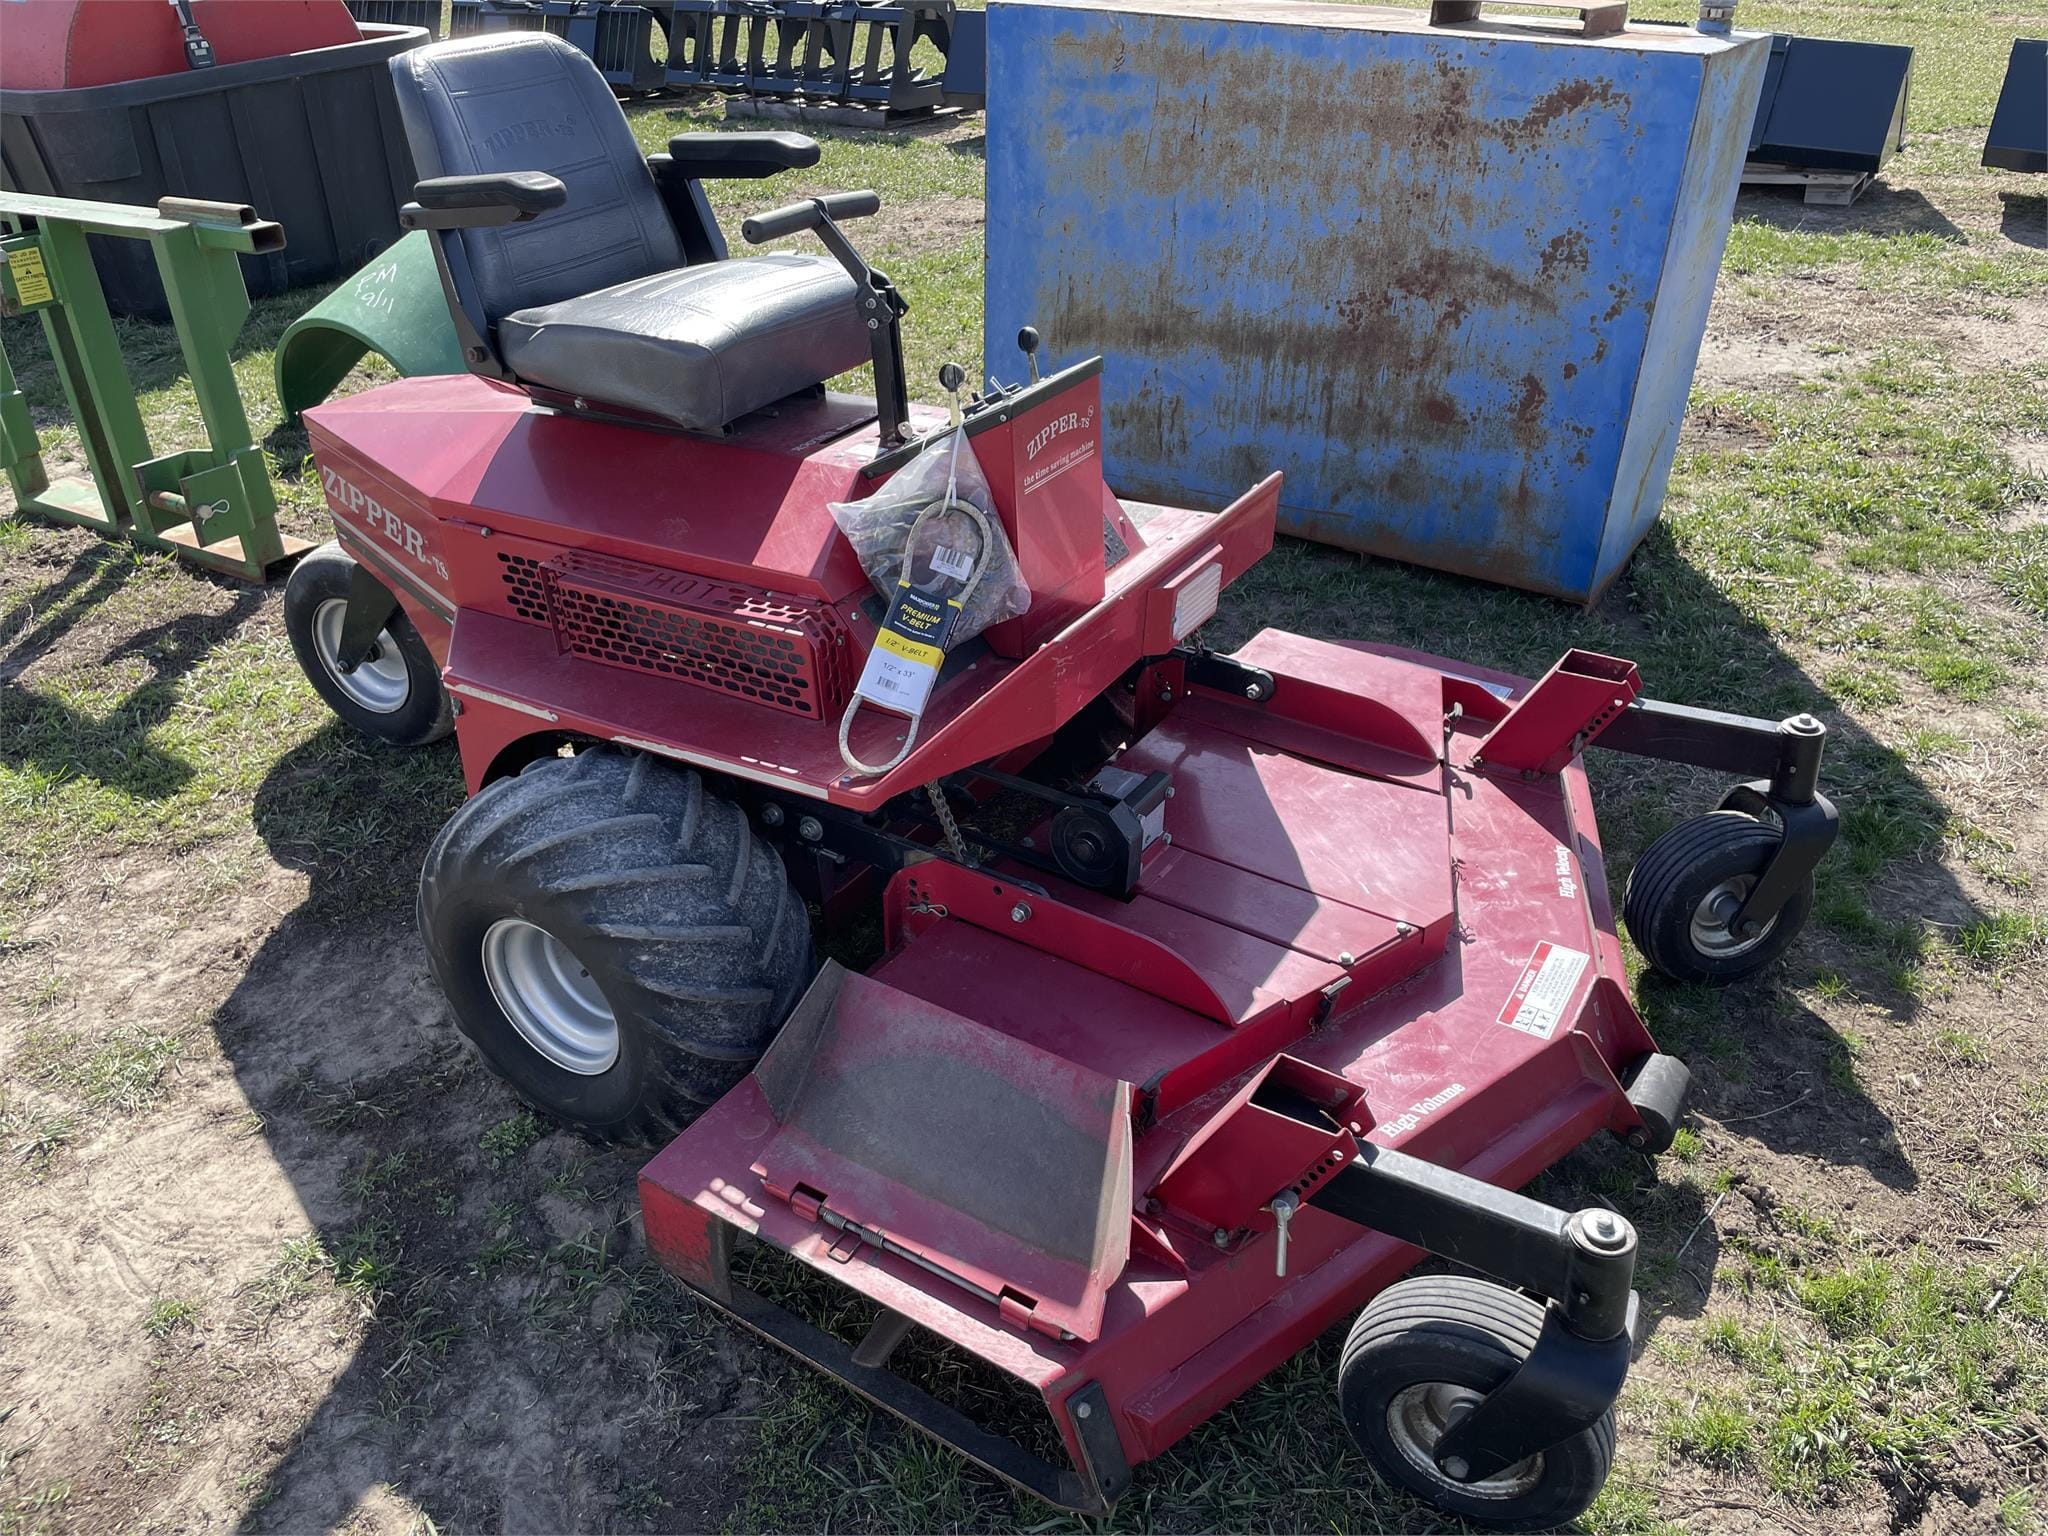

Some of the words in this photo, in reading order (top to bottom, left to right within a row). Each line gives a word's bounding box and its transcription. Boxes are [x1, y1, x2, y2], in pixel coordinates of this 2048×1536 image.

[1023, 475, 1035, 487] the
[1035, 466, 1050, 480] time
[1050, 453, 1070, 472] saving
[1070, 440, 1094, 460] machine
[643, 572, 724, 600] HOT
[900, 603, 941, 625] PREMIUM
[902, 613, 932, 630] V-BELT
[901, 645, 928, 657] V-BELT
[883, 662, 897, 672] 1/2"
[902, 670, 915, 678] 33"
[1553, 844, 1572, 876] Velocity
[1557, 877, 1577, 899] High
[1378, 1113, 1421, 1138] High
[1408, 1083, 1466, 1115] Volume
